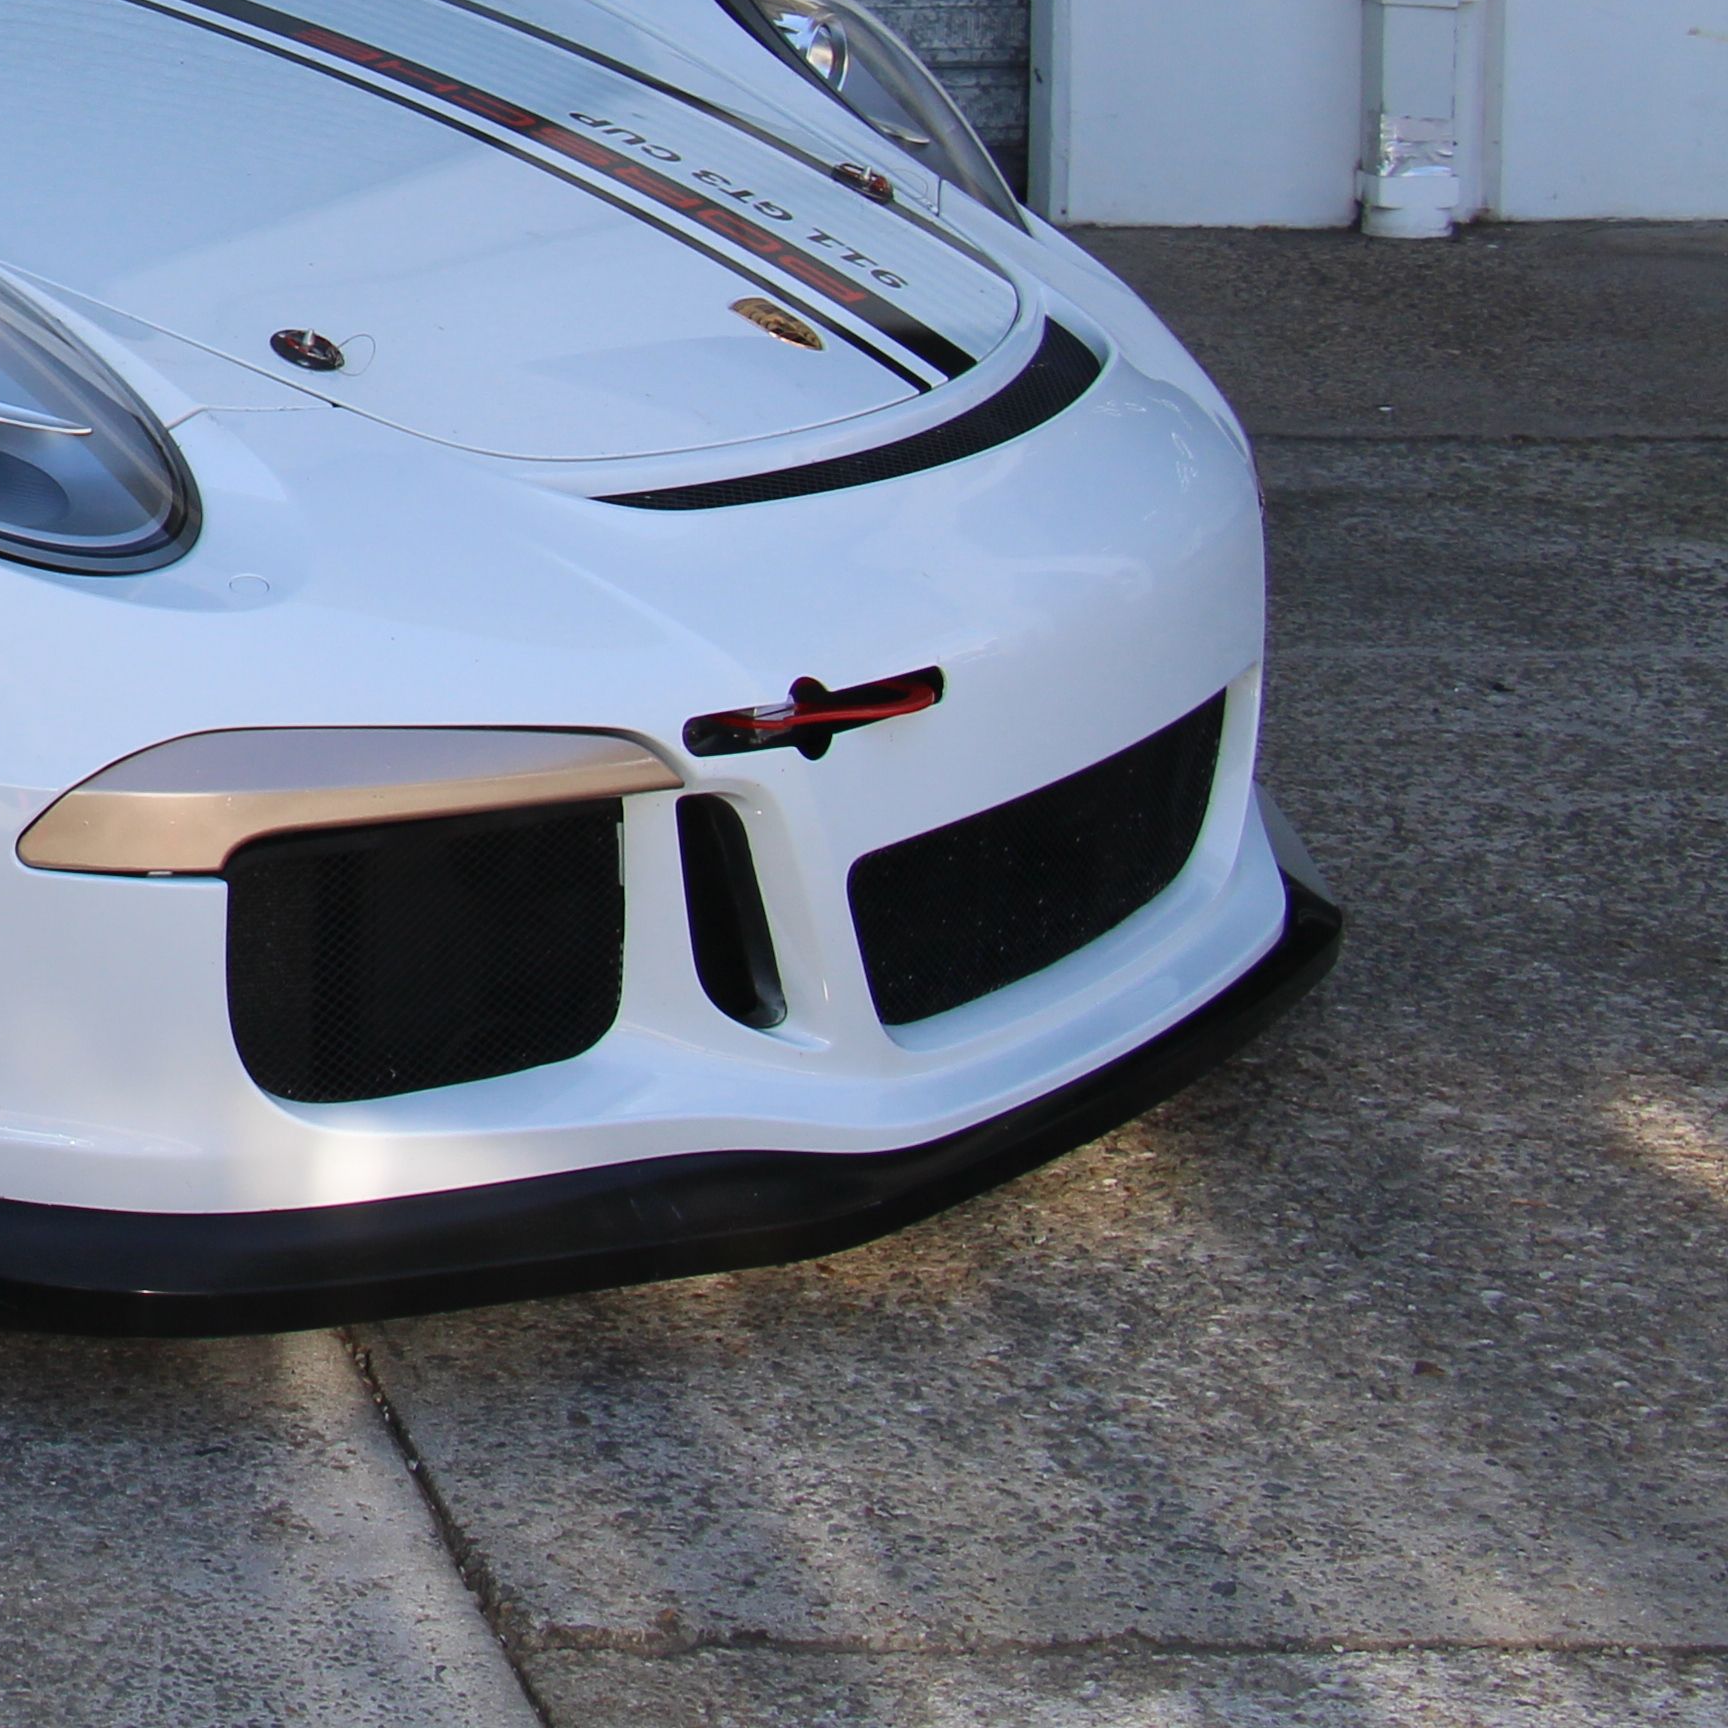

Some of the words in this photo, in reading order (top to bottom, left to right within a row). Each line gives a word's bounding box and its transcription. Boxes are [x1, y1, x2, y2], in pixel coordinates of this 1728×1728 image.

[569, 110, 683, 164] CUP
[294, 28, 871, 305] PORSCHE
[691, 168, 793, 222] GT3
[806, 227, 909, 290] 911
